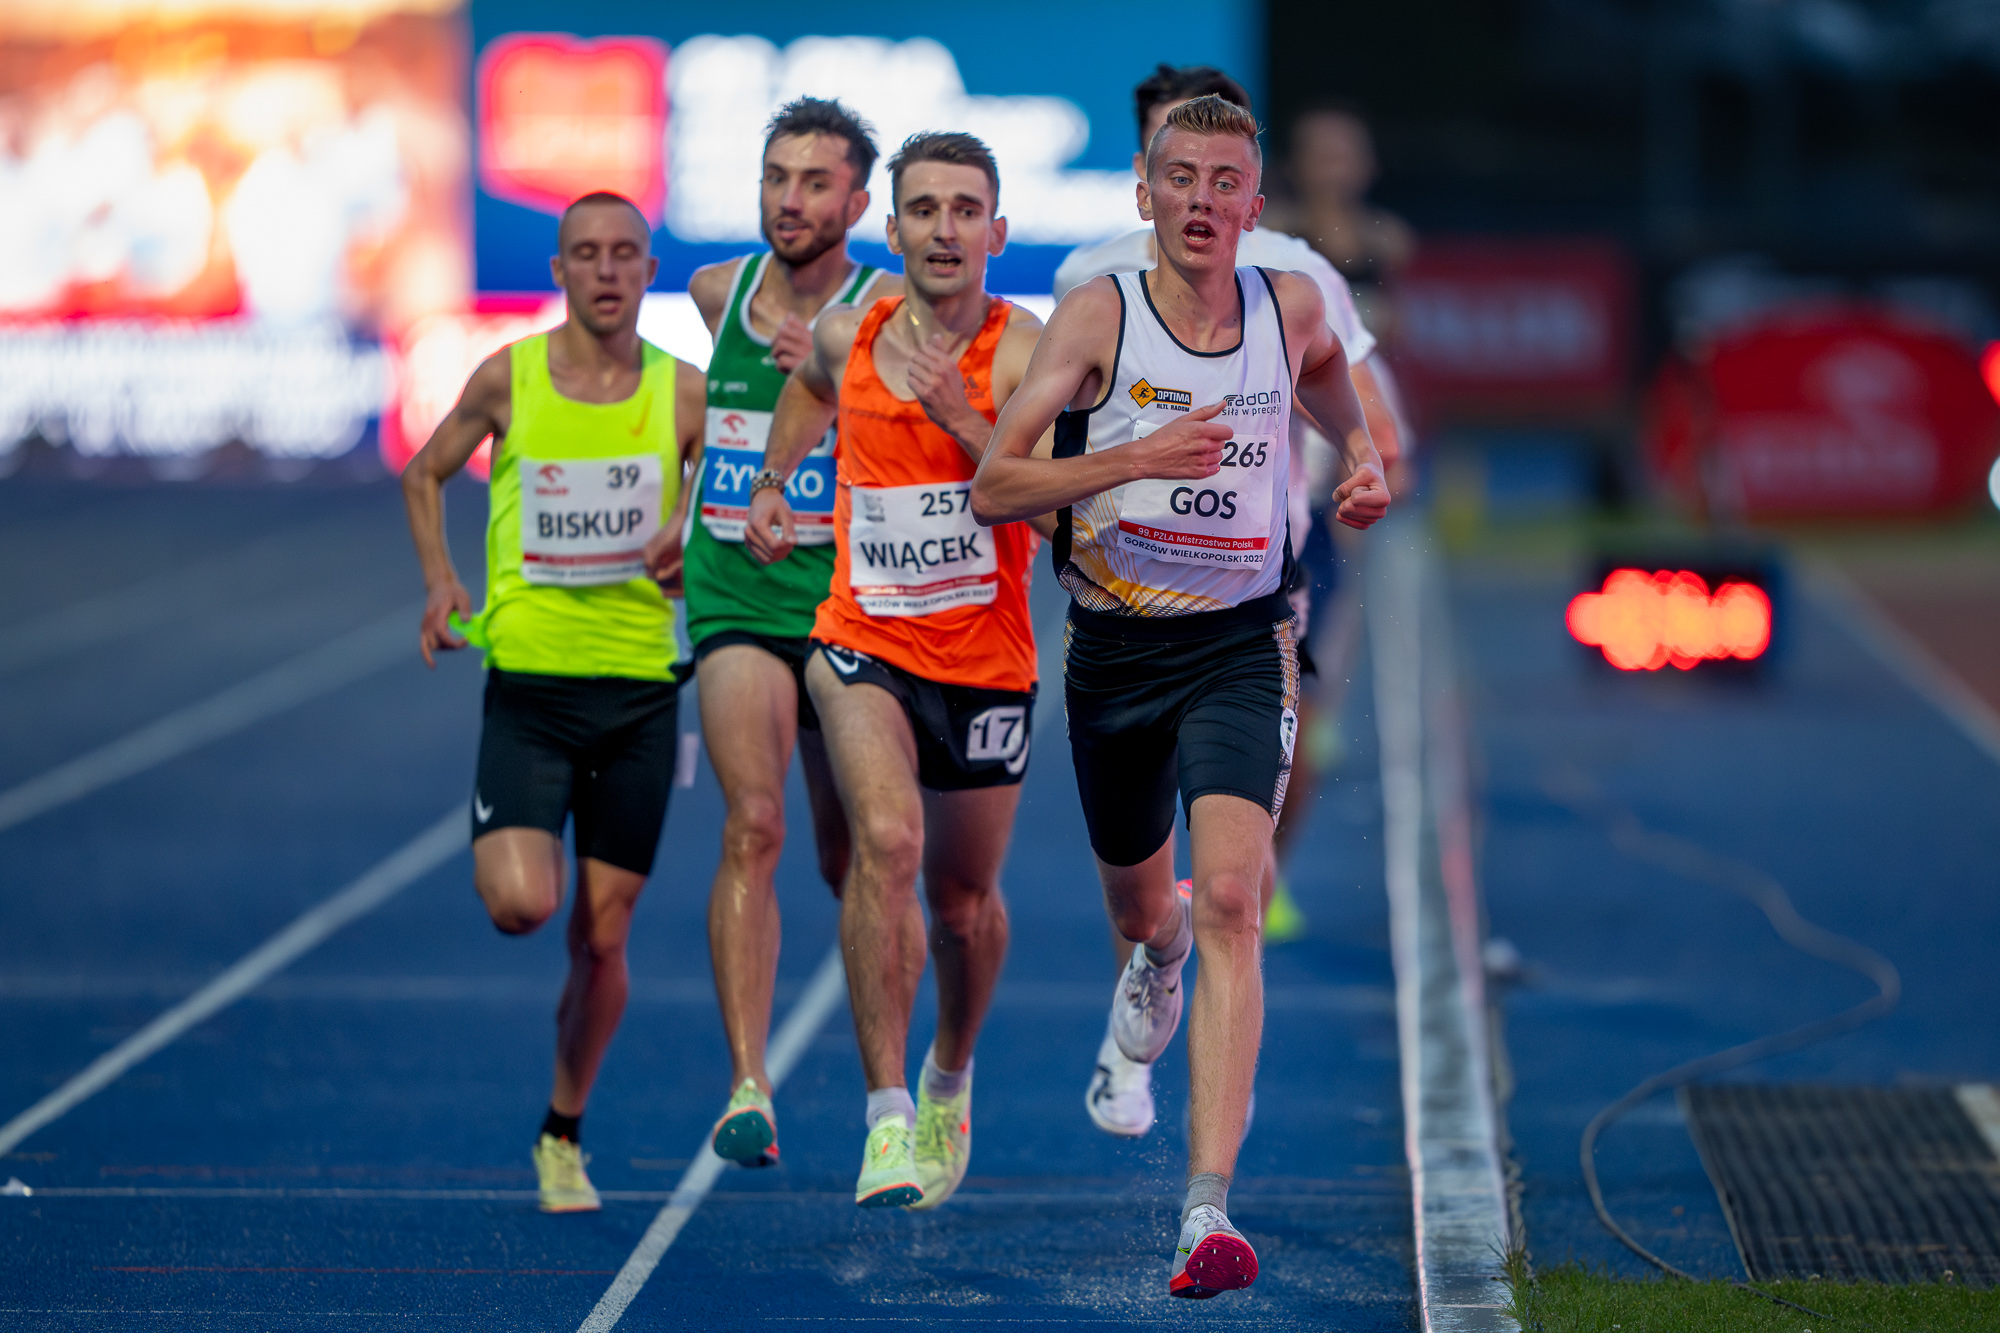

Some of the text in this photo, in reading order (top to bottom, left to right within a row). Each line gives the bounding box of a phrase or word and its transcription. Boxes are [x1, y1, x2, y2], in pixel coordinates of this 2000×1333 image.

[1157, 390, 1190, 404] OPTIMA
[1221, 406, 1239, 416] siła
[1241, 408, 1250, 416] w
[1219, 441, 1269, 468] 265
[607, 463, 641, 489] 39
[919, 488, 971, 517] 257
[1169, 486, 1238, 520] GOS
[537, 508, 644, 540] BISKUP
[1124, 536, 1264, 563] GORZÓW WIELKOPOLSKI 2023
[1138, 527, 1254, 549] 99. PZLA Mistrzostwa Polski
[860, 532, 984, 574] WIĄCEK
[973, 715, 1021, 749] 17
